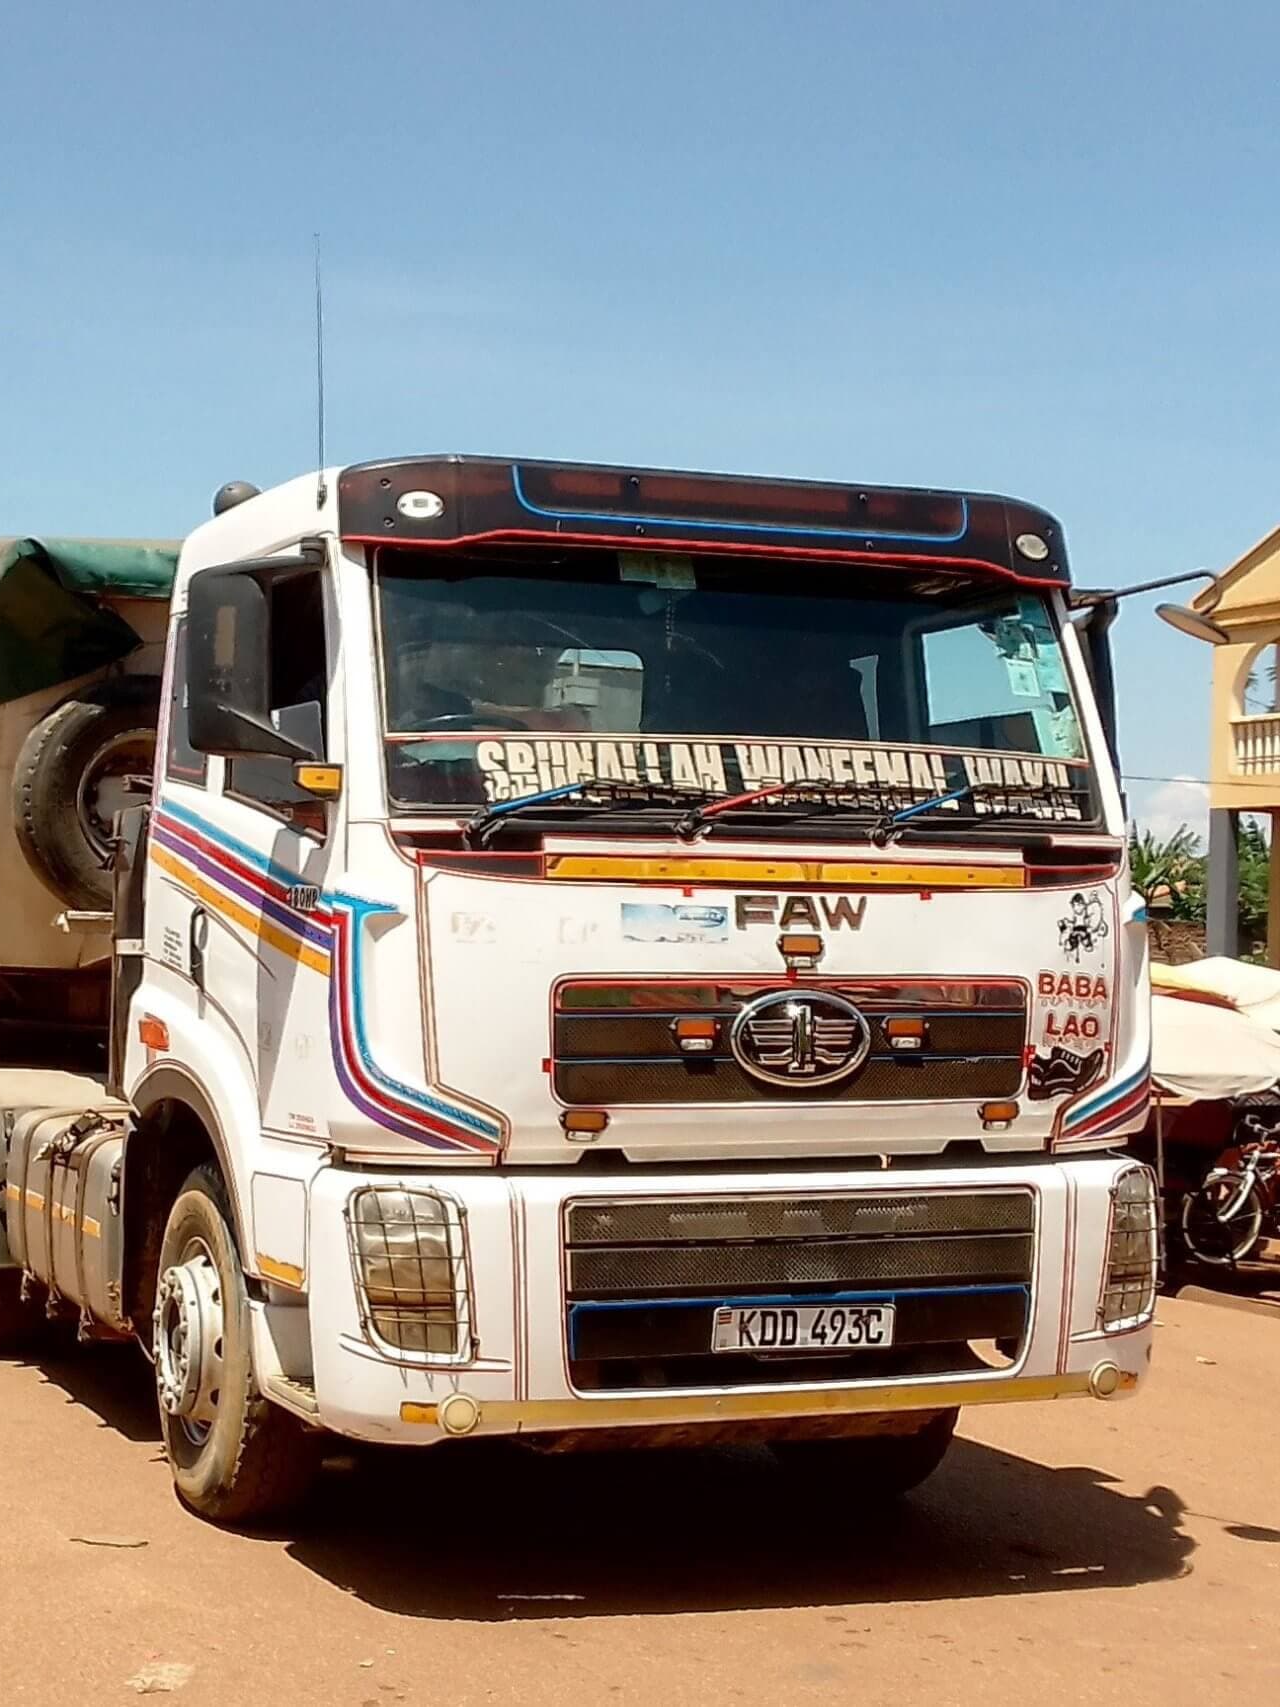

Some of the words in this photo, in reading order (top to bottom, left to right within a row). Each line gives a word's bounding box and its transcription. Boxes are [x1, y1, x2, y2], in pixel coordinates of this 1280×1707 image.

[734, 894, 867, 931] FAW
[1038, 972, 1108, 999] BABA
[1046, 1012, 1099, 1037] LAO
[738, 1309, 798, 1347] KDD
[811, 1308, 883, 1345] 493C
